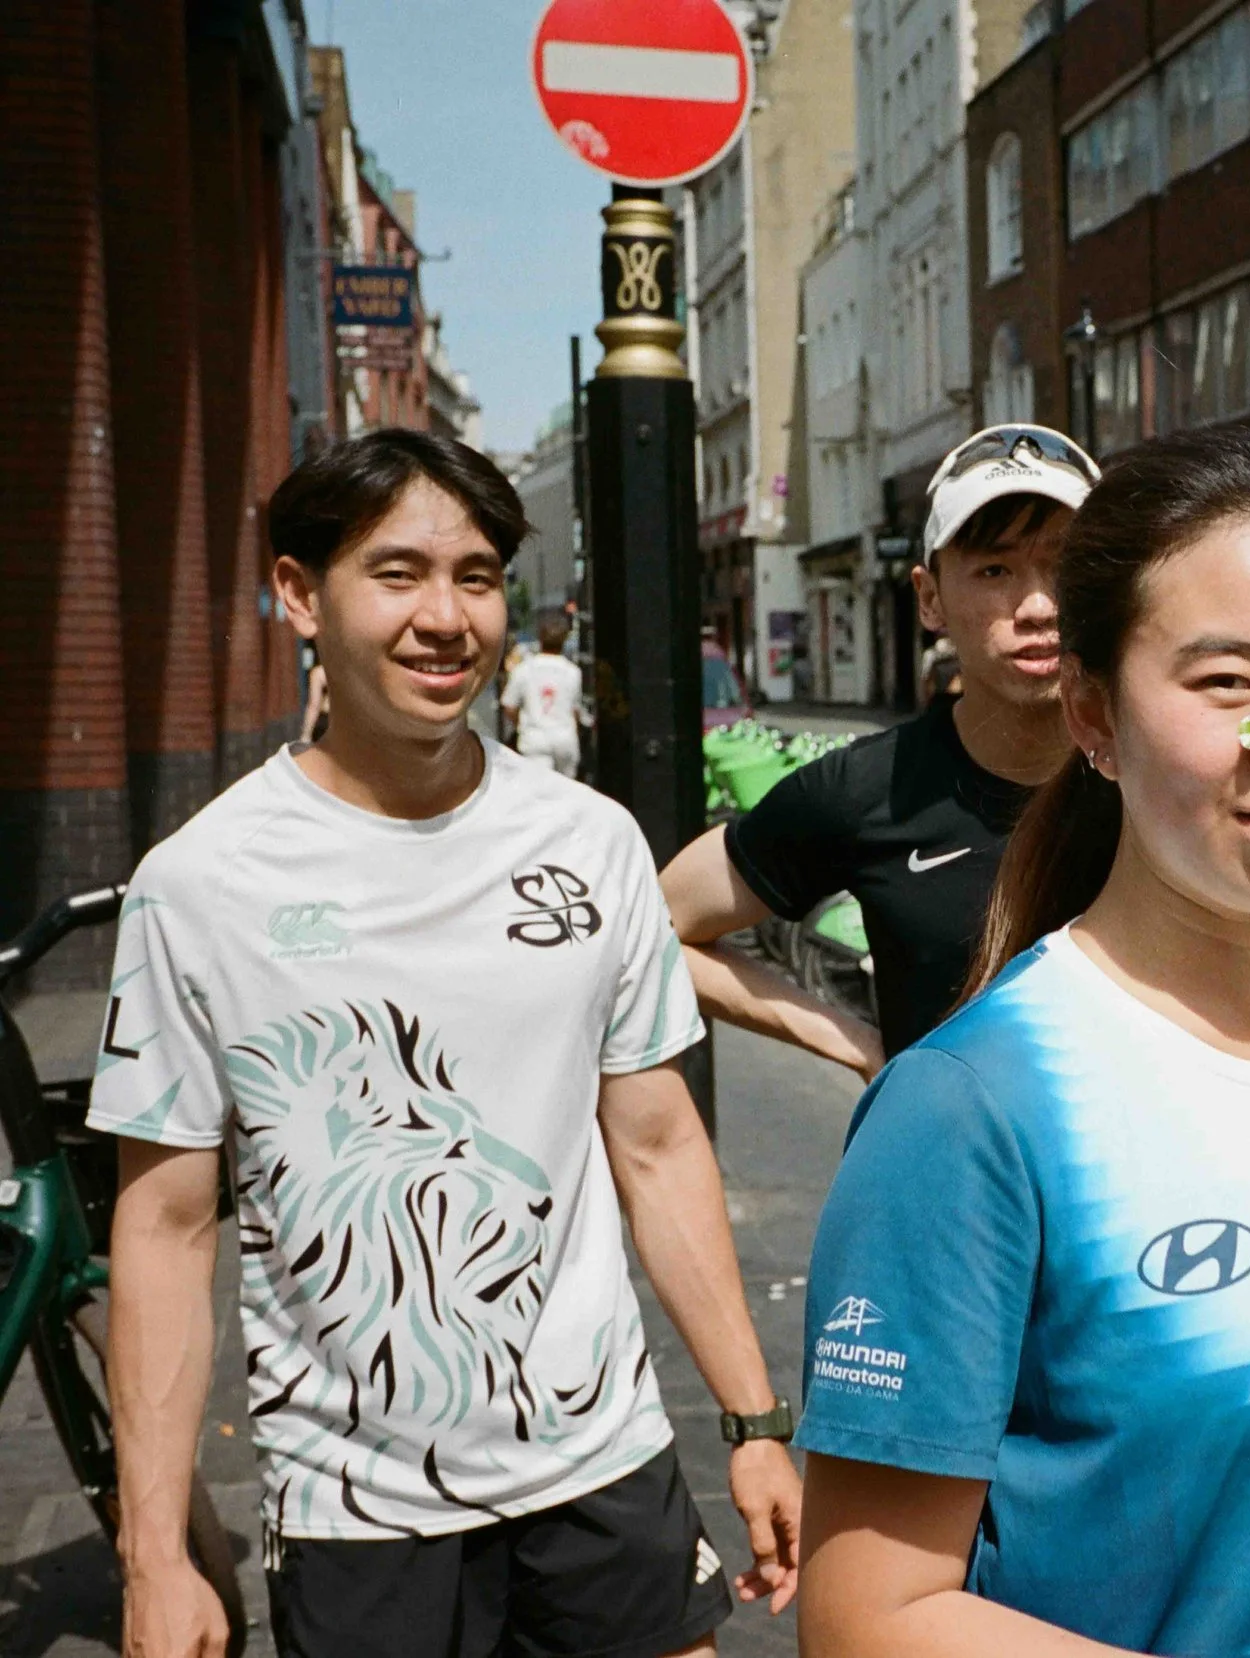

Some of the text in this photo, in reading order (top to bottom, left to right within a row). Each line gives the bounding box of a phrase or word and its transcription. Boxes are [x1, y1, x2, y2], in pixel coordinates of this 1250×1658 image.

[984, 466, 1042, 481] adidas
[103, 995, 140, 1060] L
[823, 1341, 906, 1371] HYUNDAI
[821, 1361, 903, 1391] Maratona
